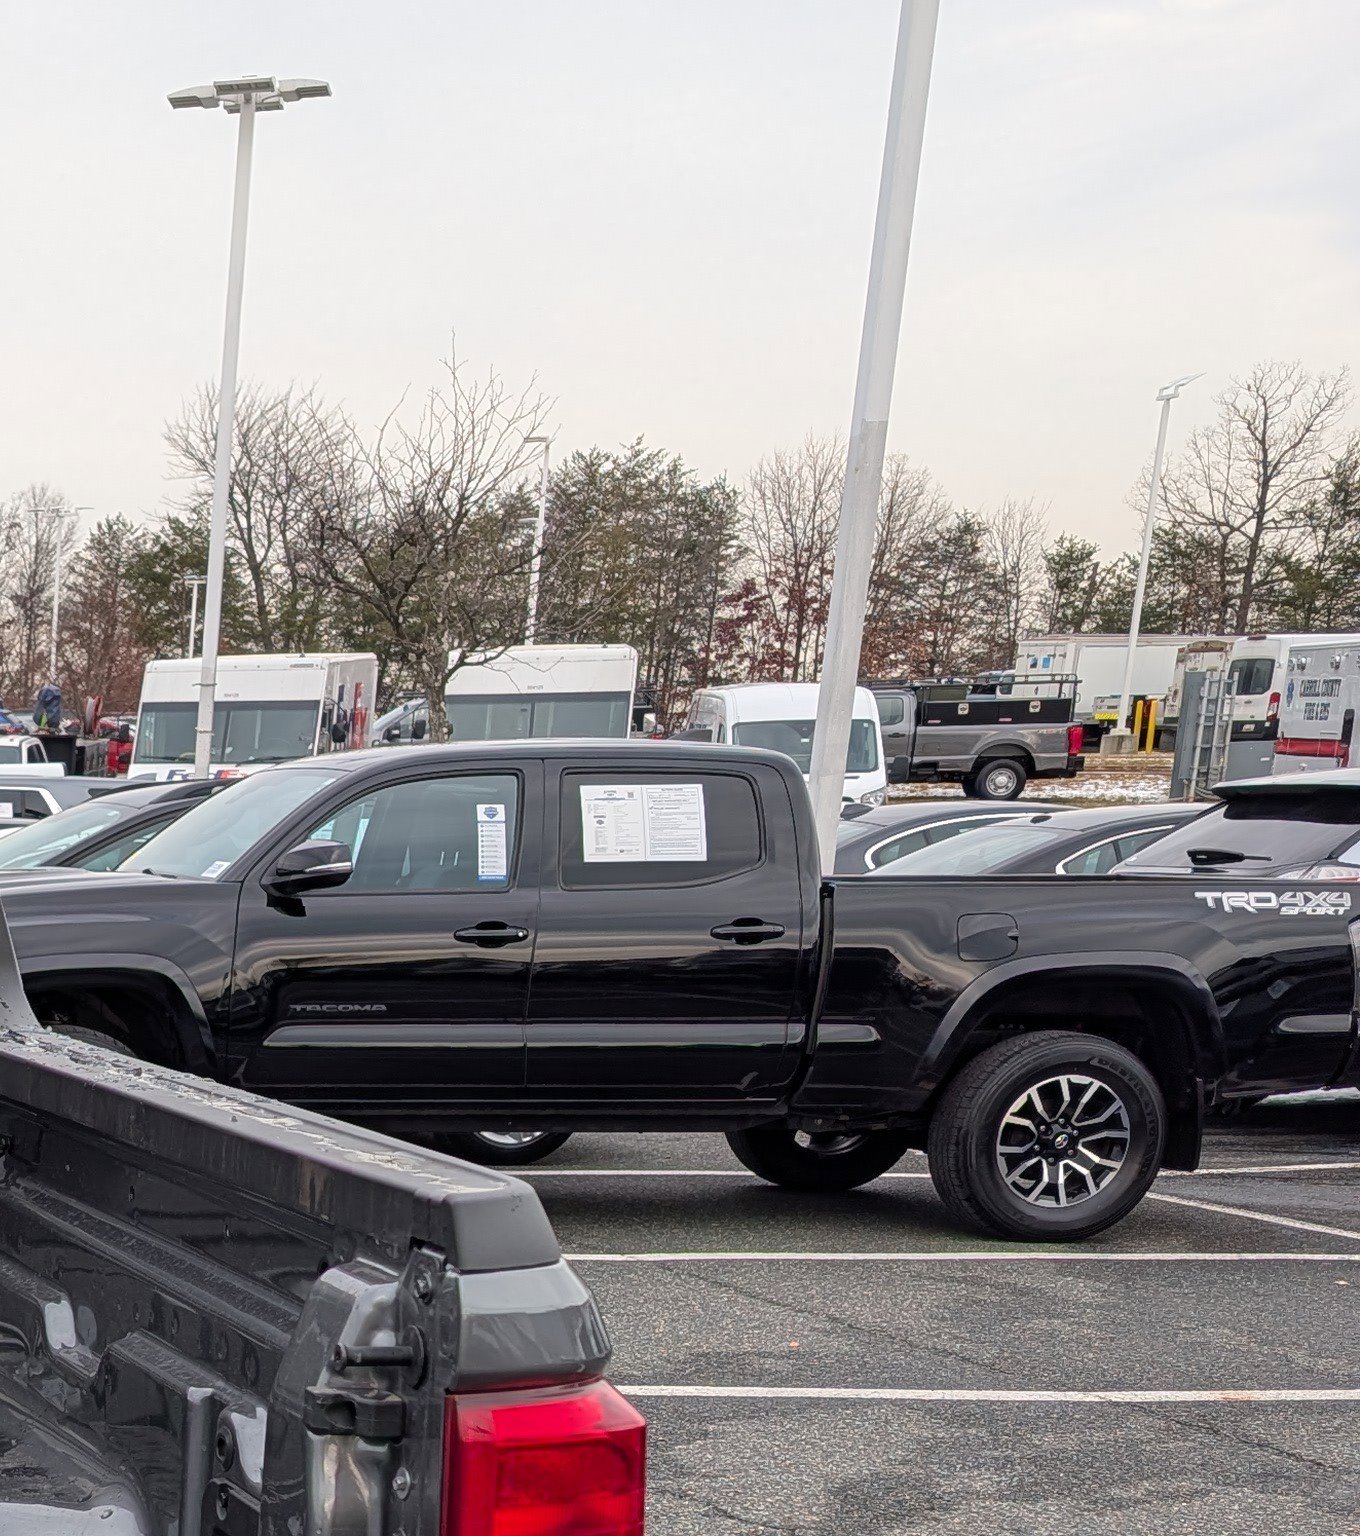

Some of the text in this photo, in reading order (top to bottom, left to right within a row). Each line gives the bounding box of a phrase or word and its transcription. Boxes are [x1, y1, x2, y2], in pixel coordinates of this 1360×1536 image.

[1194, 891, 1280, 914] TRD
[1280, 906, 1351, 915] SPORT
[289, 1004, 388, 1012] TACOMA
